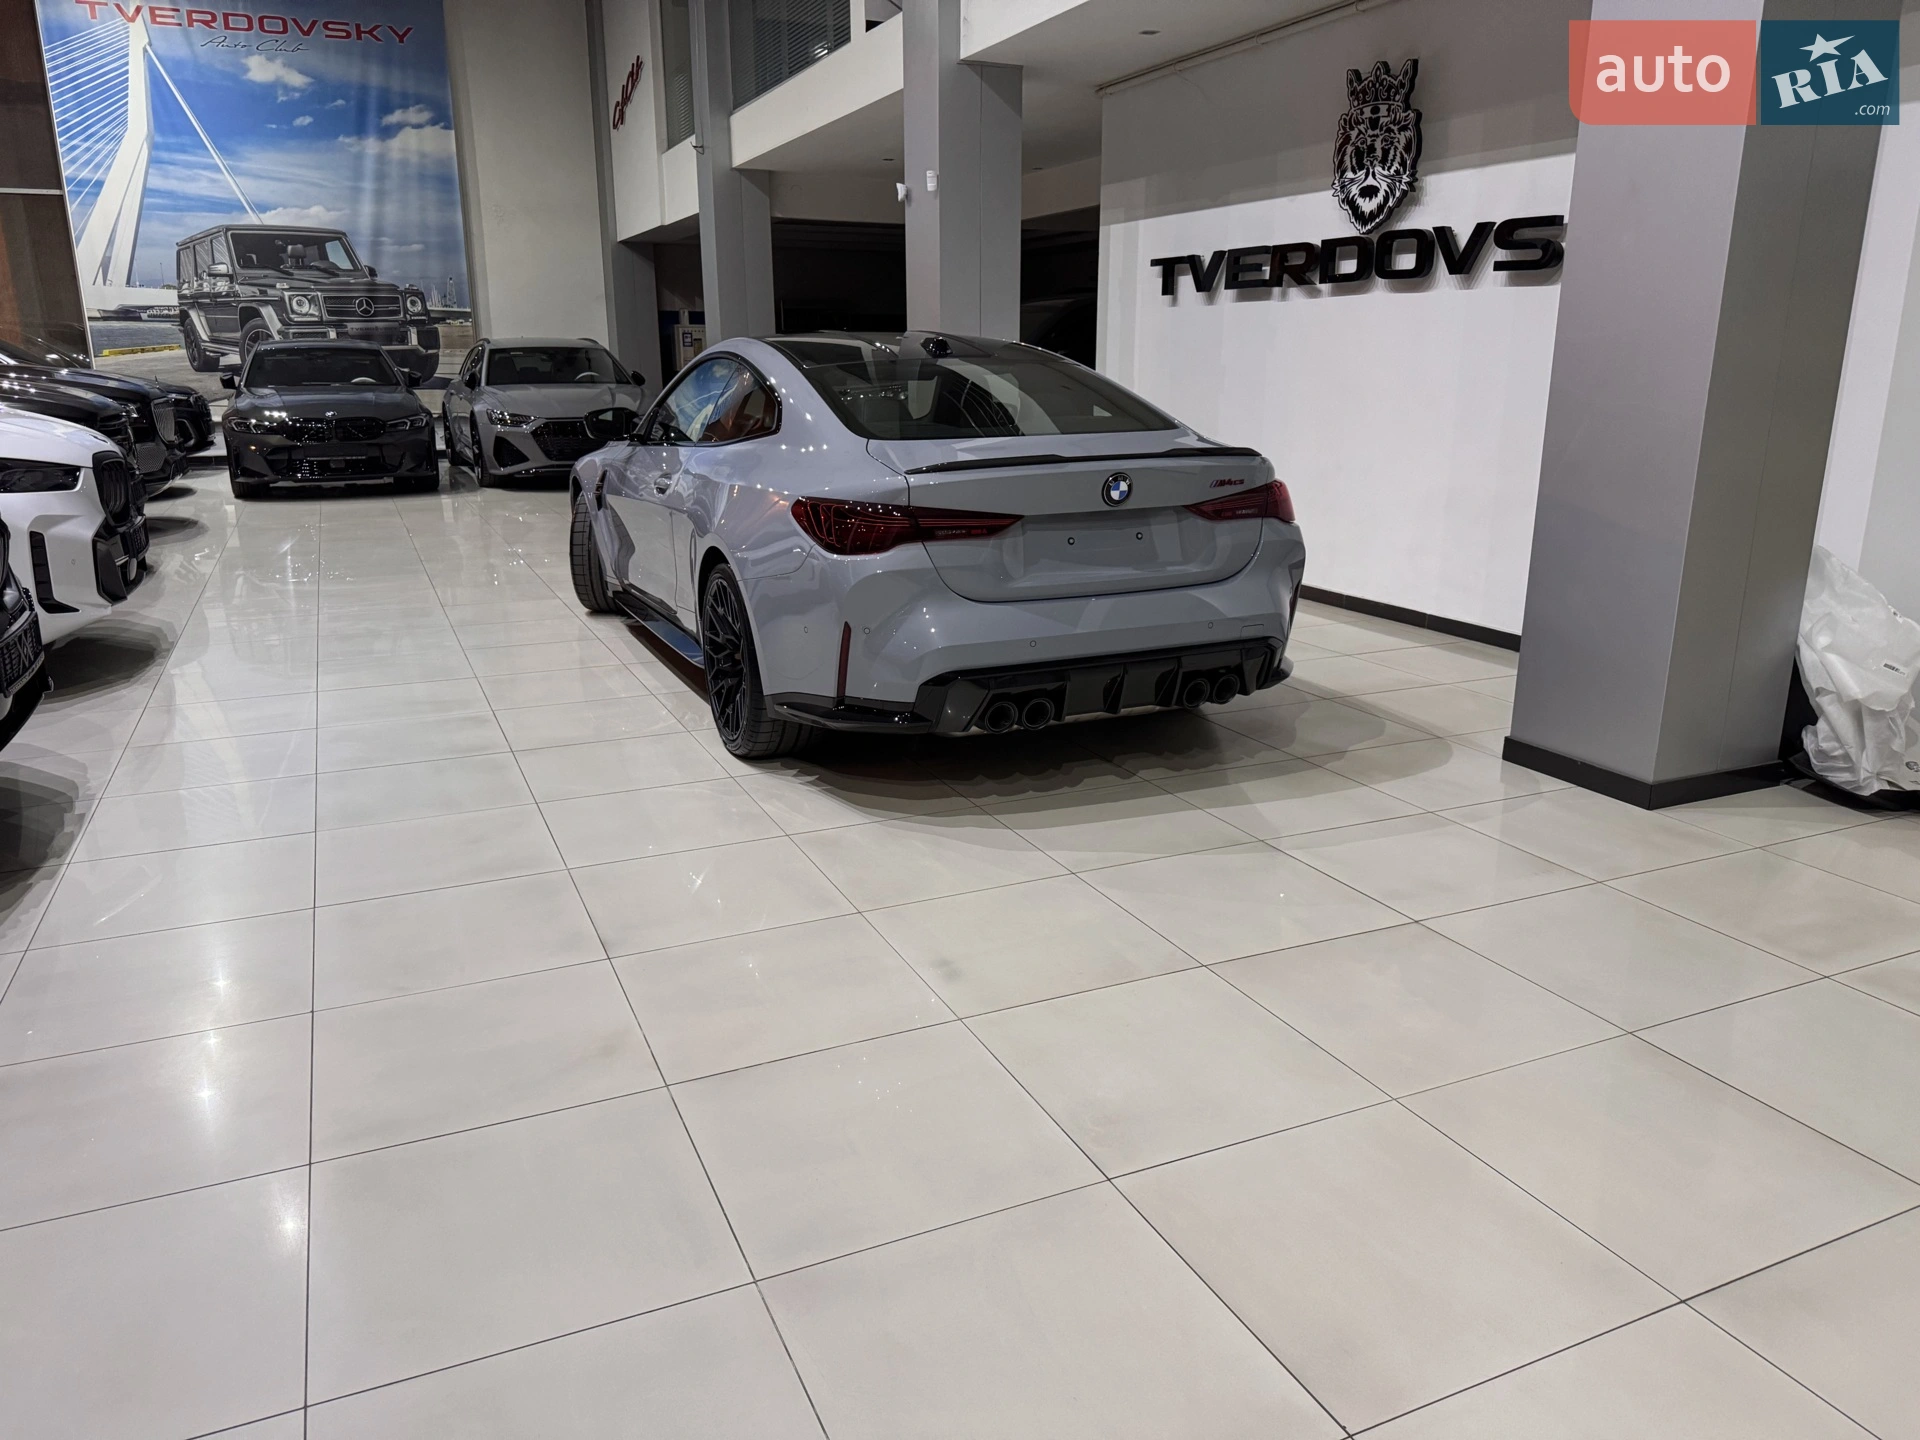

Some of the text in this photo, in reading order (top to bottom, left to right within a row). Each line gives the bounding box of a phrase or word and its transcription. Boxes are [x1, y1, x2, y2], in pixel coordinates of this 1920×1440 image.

[75, 0, 414, 44] TVERDOVSKY
[200, 35, 310, 53] Auto Club
[1150, 214, 1565, 297] TVERDOVS
